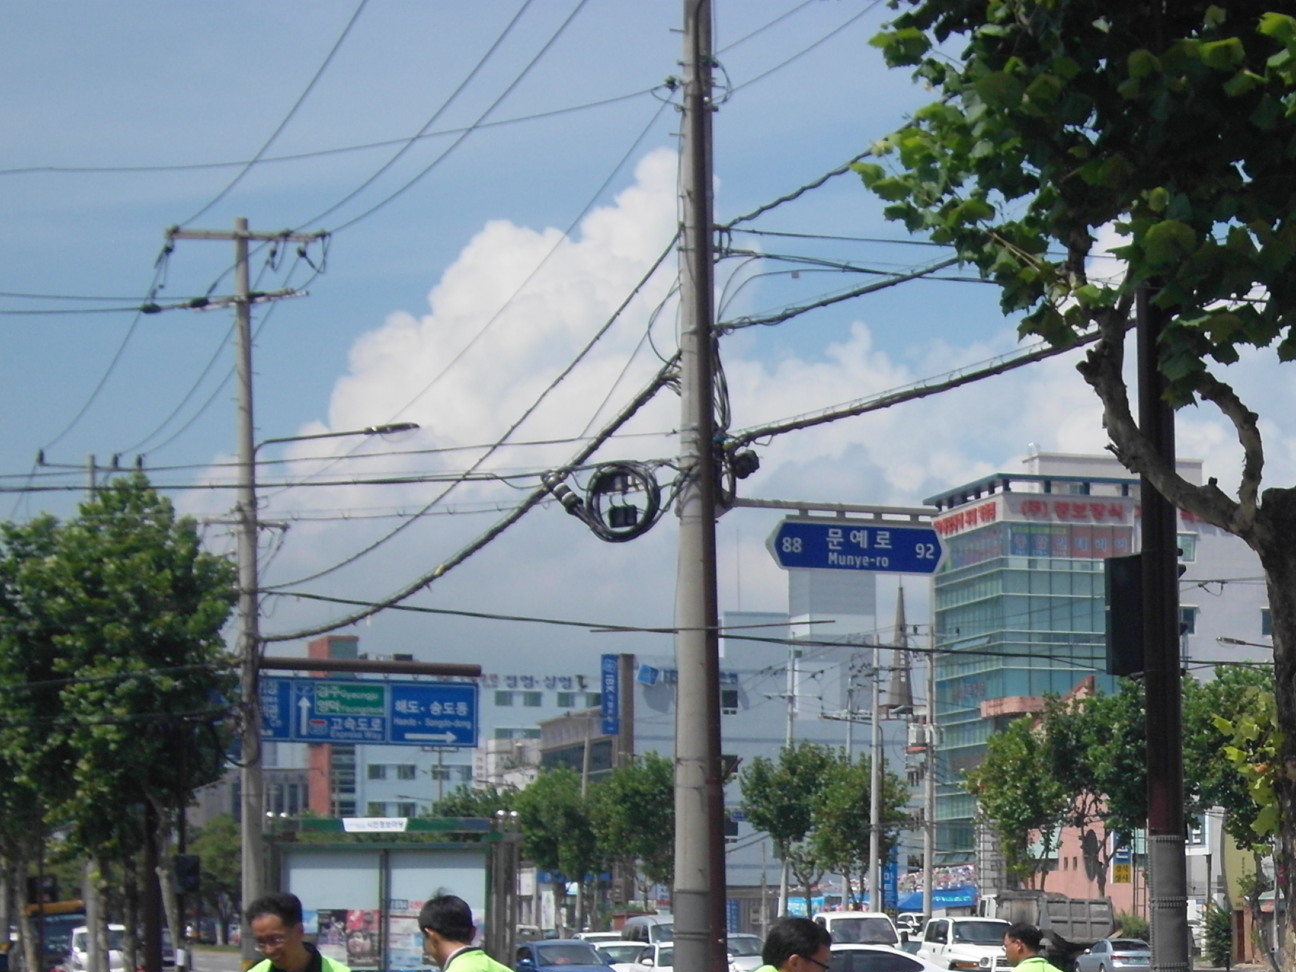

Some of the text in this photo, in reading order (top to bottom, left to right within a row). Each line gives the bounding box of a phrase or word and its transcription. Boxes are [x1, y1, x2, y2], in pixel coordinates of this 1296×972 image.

[782, 537, 802, 552] 88
[826, 528, 892, 550] 문예로
[915, 543, 935, 559] 92
[828, 552, 889, 568] Munye-ro
[429, 701, 468, 716] 송도동
[330, 717, 384, 731] 고속도로
